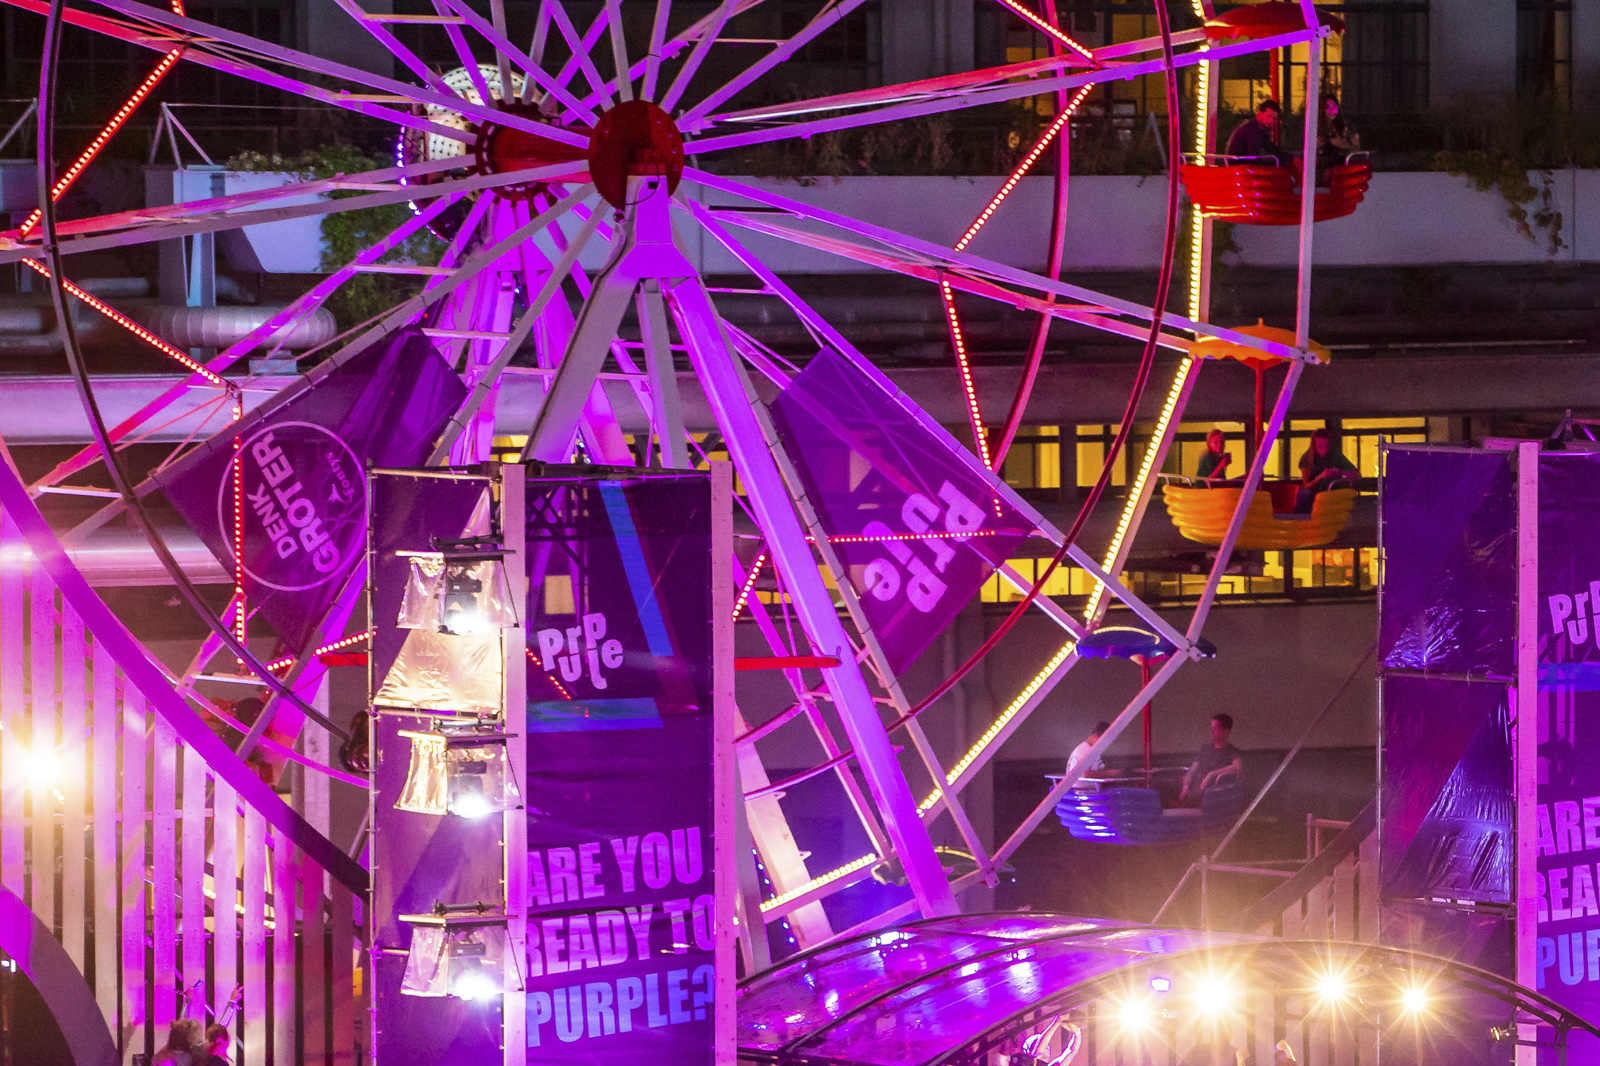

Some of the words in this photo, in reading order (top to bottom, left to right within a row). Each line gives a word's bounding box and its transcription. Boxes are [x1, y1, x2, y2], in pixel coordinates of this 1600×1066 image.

[246, 482, 299, 560] DENK
[252, 431, 340, 573] GROTER
[527, 841, 605, 908] ARE
[610, 826, 703, 893] YOU
[662, 894, 715, 955] TO
[526, 963, 716, 1048] PURPLE?
